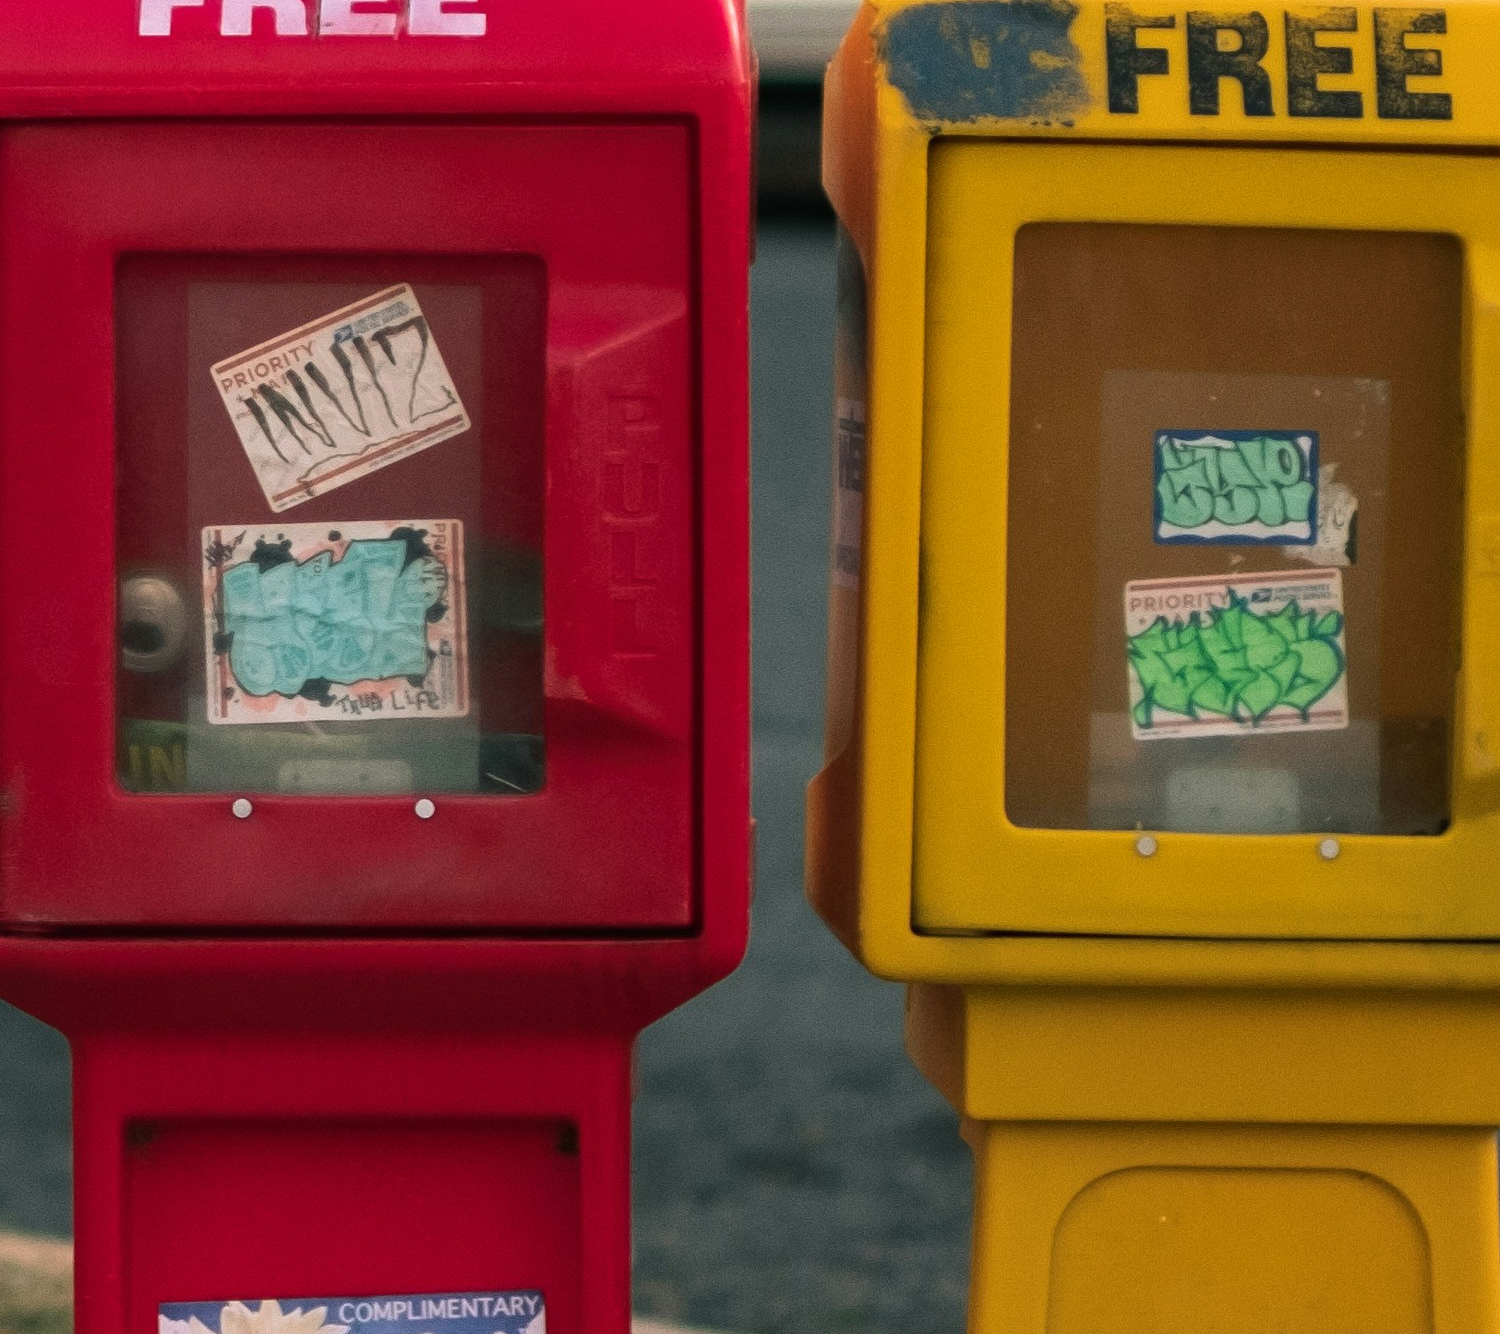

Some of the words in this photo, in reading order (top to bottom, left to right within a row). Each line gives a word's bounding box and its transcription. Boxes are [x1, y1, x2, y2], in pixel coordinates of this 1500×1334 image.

[1104, 1, 1454, 121] FREE
[220, 339, 317, 395] PRIORITY
[601, 394, 662, 661] PULL
[338, 1295, 541, 1324] COMPLIMENTARY
